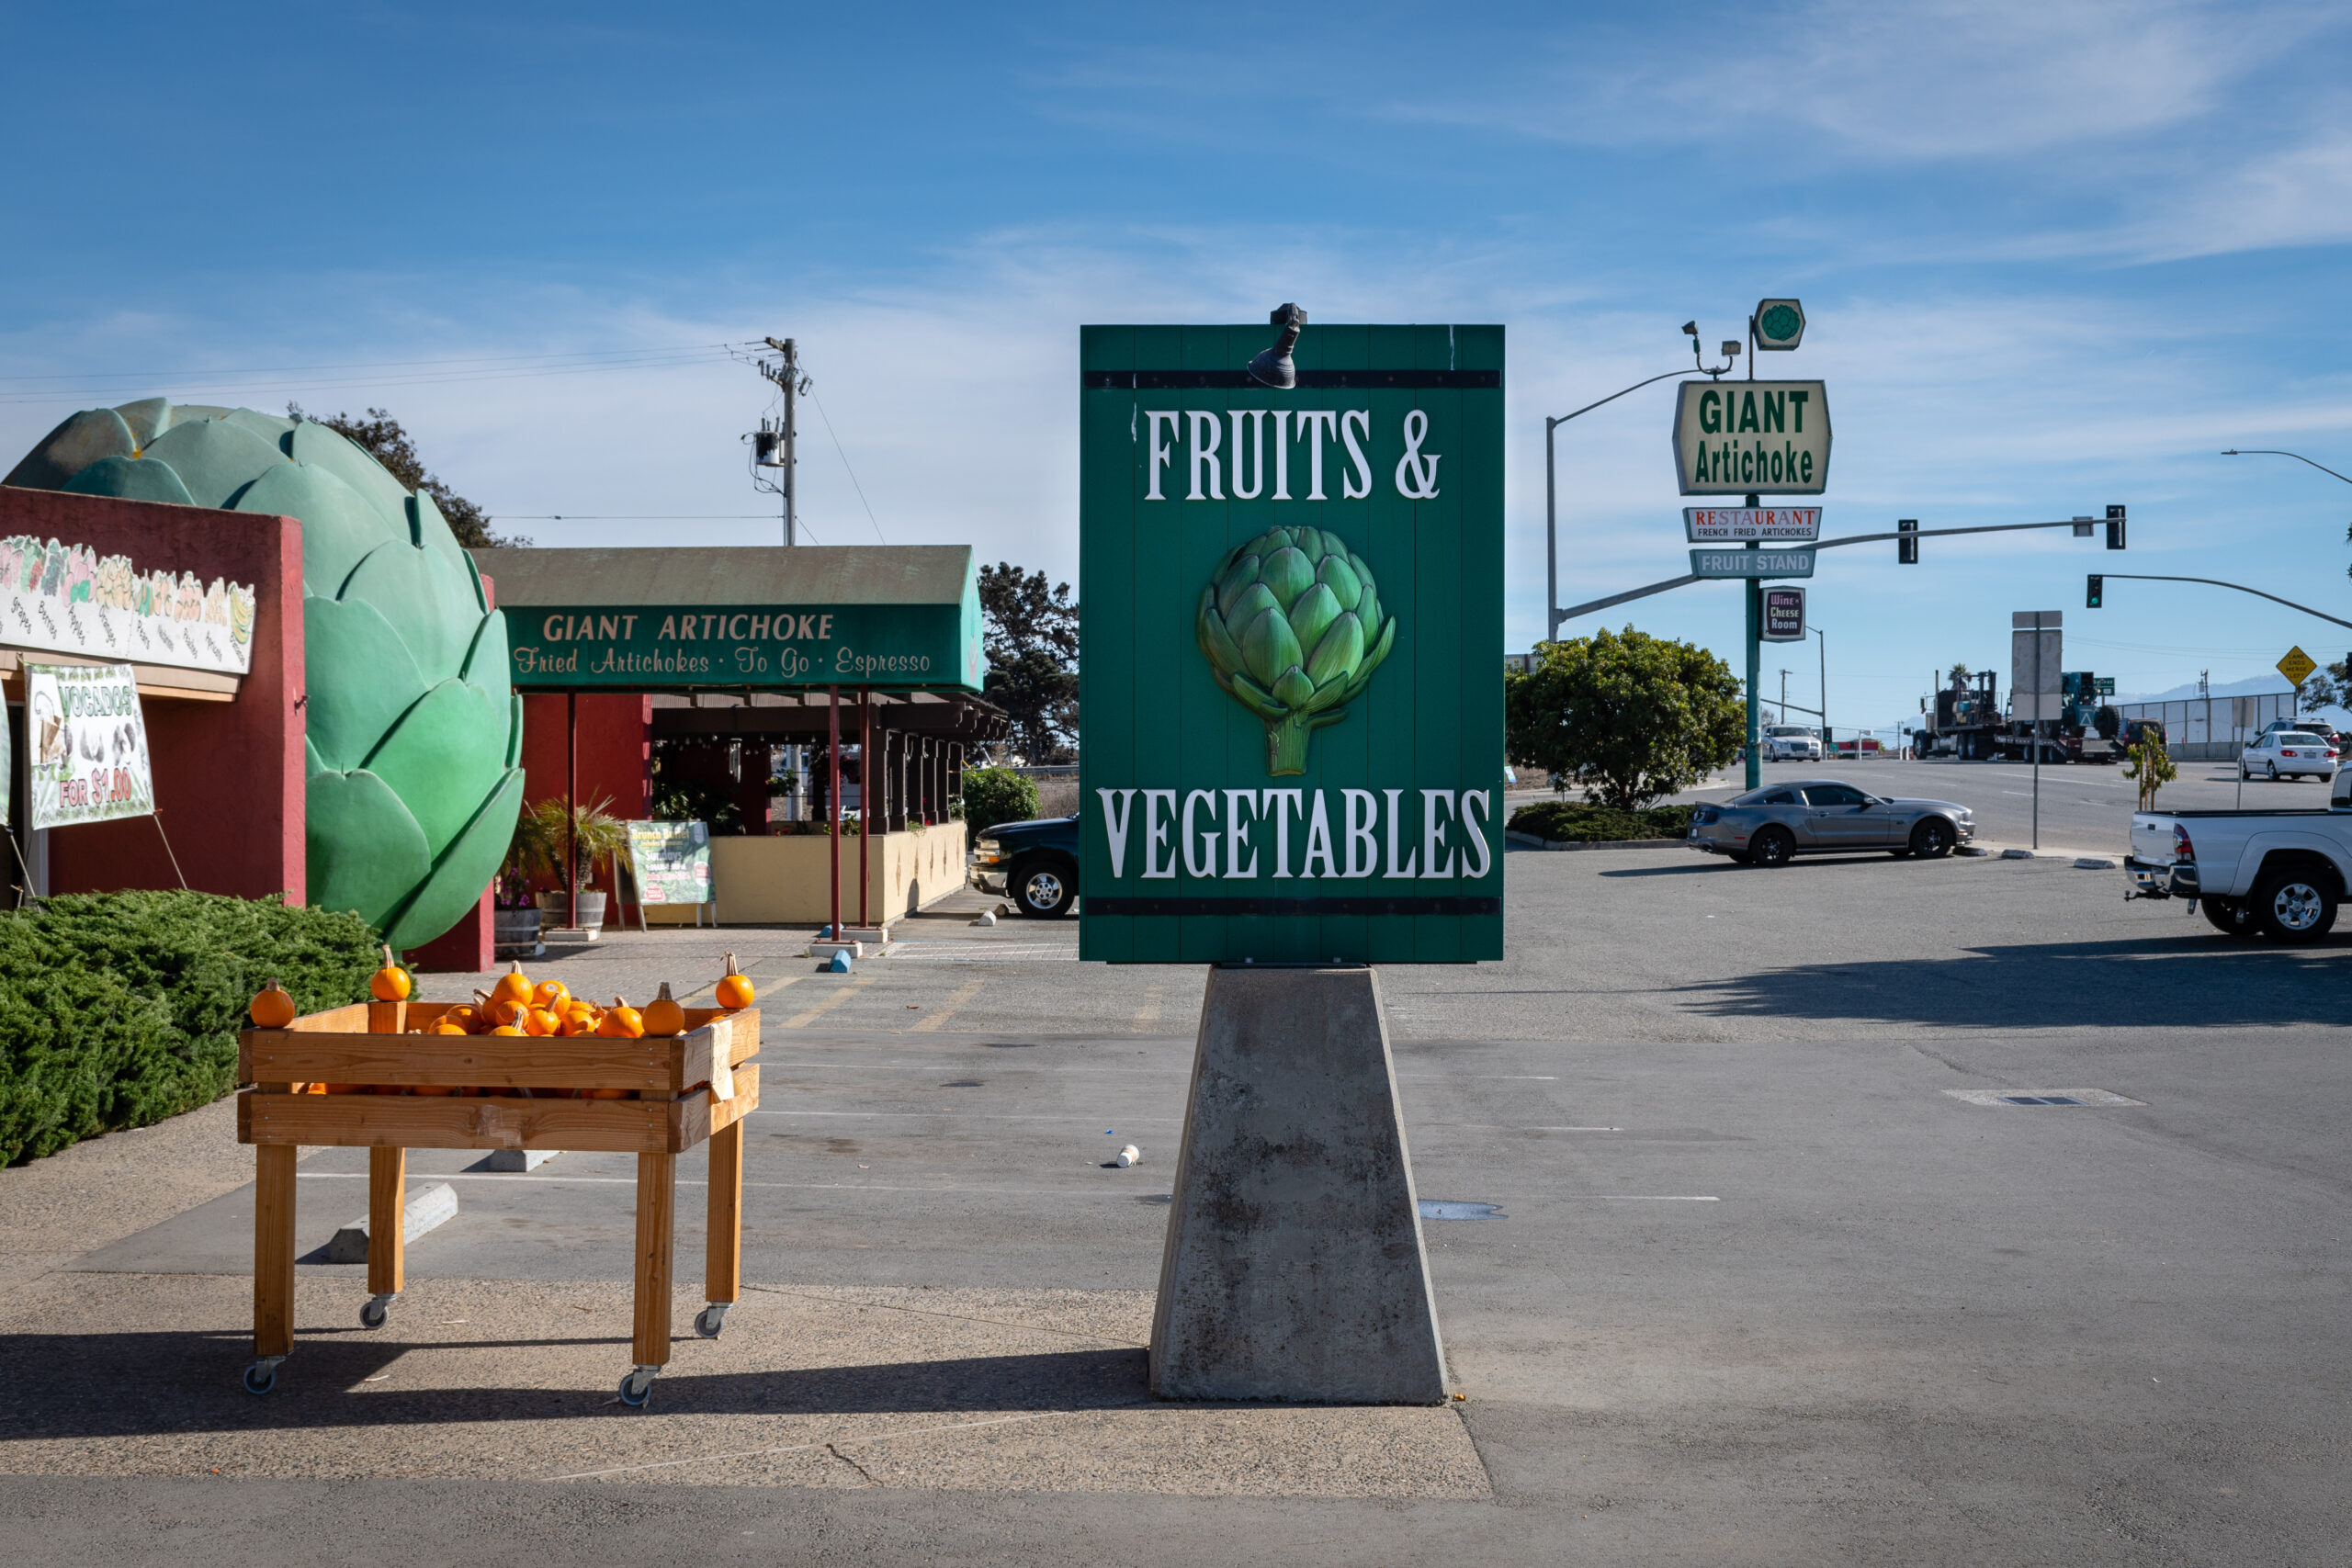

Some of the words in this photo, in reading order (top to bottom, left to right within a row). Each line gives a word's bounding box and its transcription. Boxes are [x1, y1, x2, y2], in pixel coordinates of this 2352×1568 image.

[1699, 389, 1809, 434] GIANT
[1144, 410, 1372, 500] FRUITS
[1395, 409, 1442, 500] &
[1695, 439, 1813, 484] Artichoke
[1696, 510, 1815, 525] RESTAURANT
[1698, 527, 1728, 536] FRENCH
[1734, 527, 1757, 536] FRIED
[1761, 527, 1812, 536] ARTICHOKES
[1702, 554, 1749, 570] FRUIT
[1757, 554, 1809, 570] STAND
[543, 615, 639, 641] GIANT
[657, 615, 833, 640] ARTICHOKE
[1771, 618, 1798, 629] Room
[514, 647, 578, 673] Fried
[591, 648, 709, 673] Artichokes
[735, 647, 767, 672] To
[781, 648, 809, 678] Go
[835, 647, 930, 678] Espresso
[59, 685, 132, 717] VOCADOS
[60, 779, 88, 807] FOR
[92, 767, 131, 807] $1.00
[1096, 788, 1490, 878] VEGETABLES
[645, 848, 683, 863] Sundays
